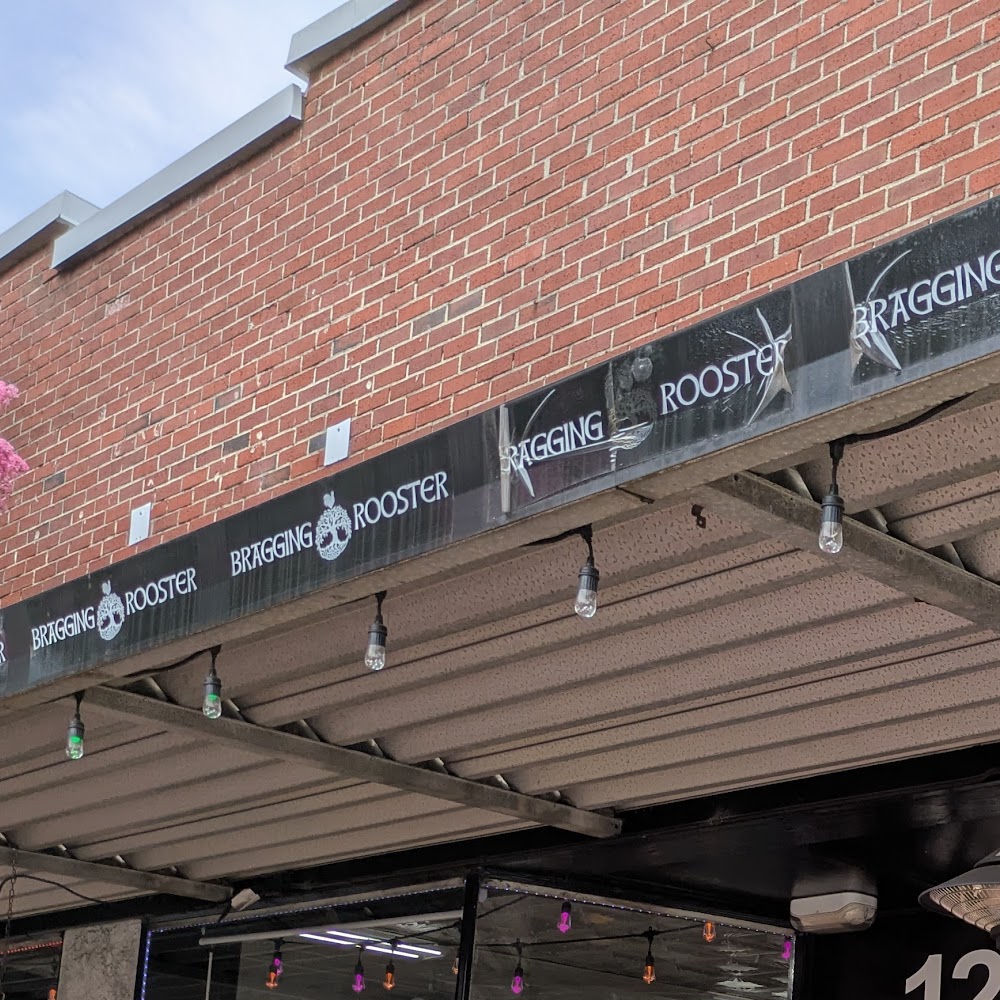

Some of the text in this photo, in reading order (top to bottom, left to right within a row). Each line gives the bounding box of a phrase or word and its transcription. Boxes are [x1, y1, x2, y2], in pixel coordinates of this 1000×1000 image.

[230, 470, 450, 577] BRAGGING ROOSTER
[31, 567, 198, 651] BRAGGING ROOSTER
